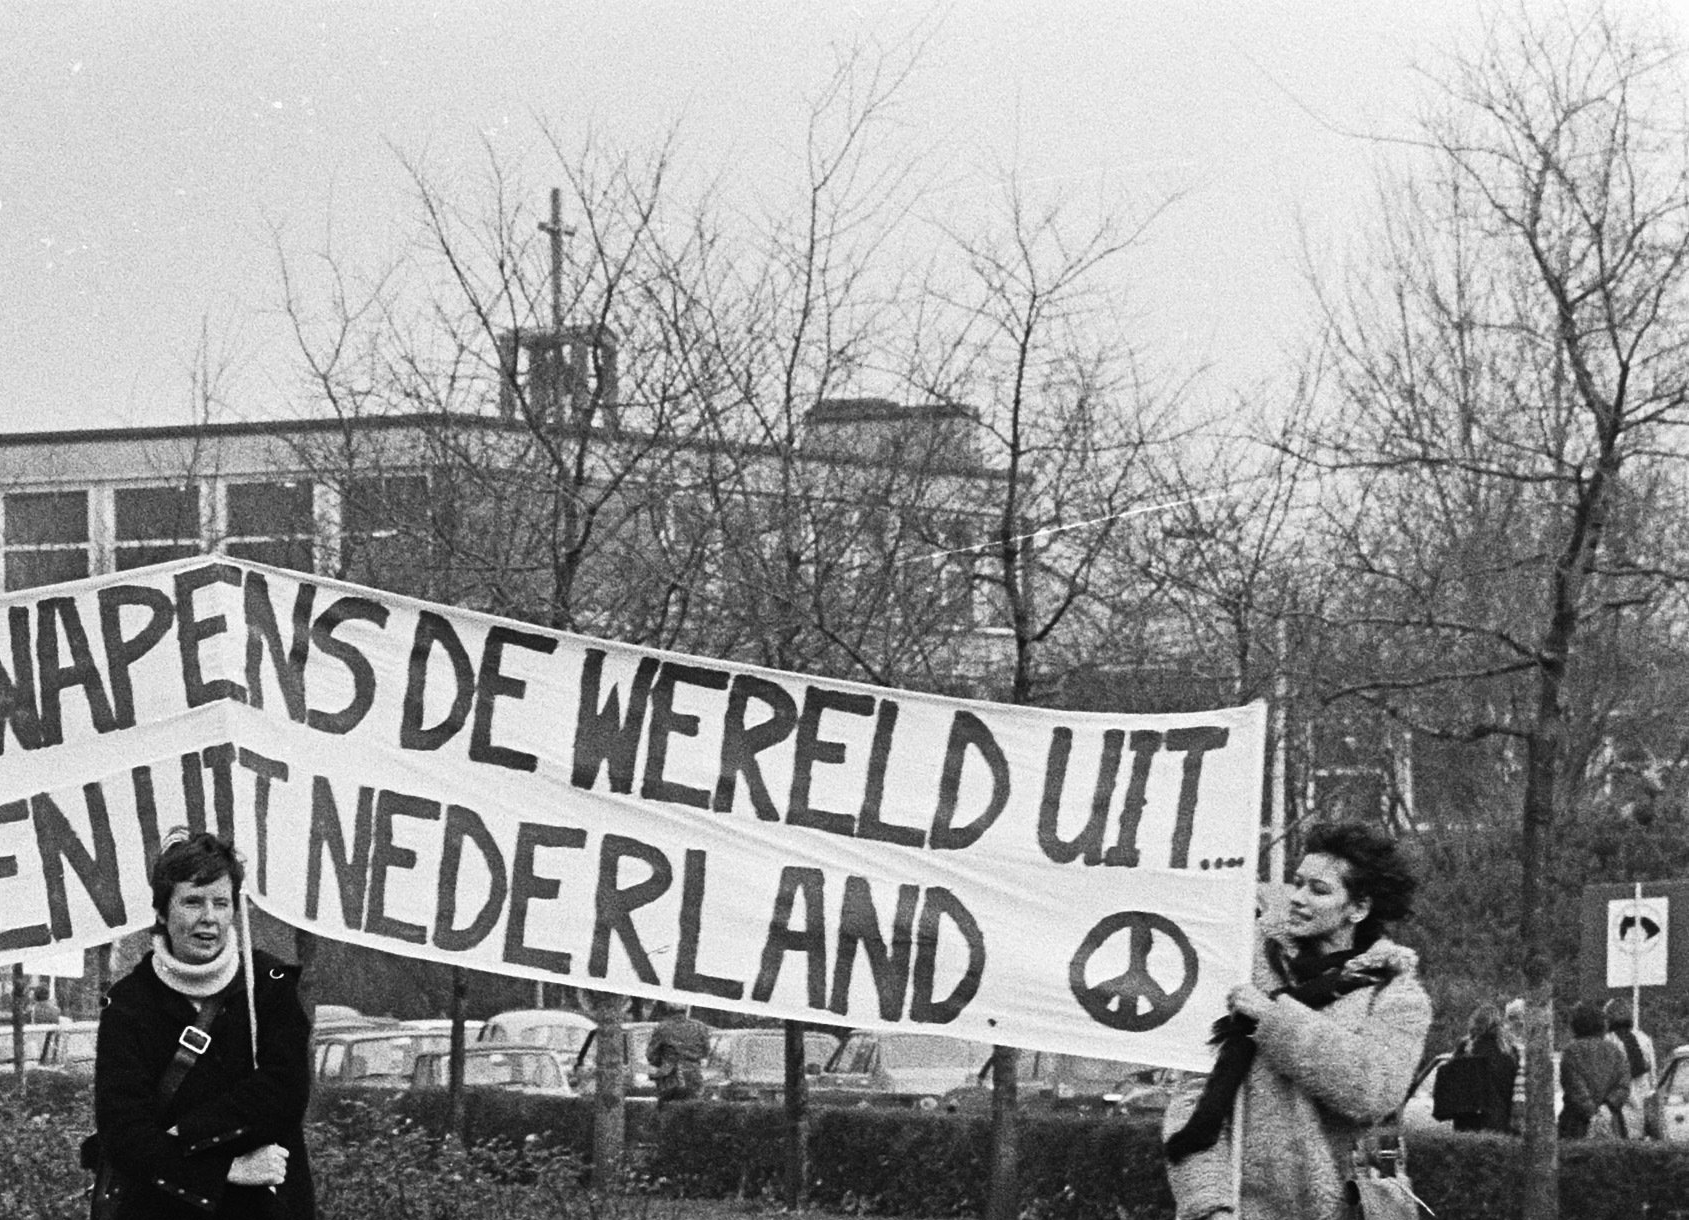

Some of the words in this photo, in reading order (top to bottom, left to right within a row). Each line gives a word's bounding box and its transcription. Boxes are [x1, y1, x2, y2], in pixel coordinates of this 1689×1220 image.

[131, 741, 290, 897] UIT
[398, 611, 562, 775] DE
[570, 648, 1012, 852] WERELD
